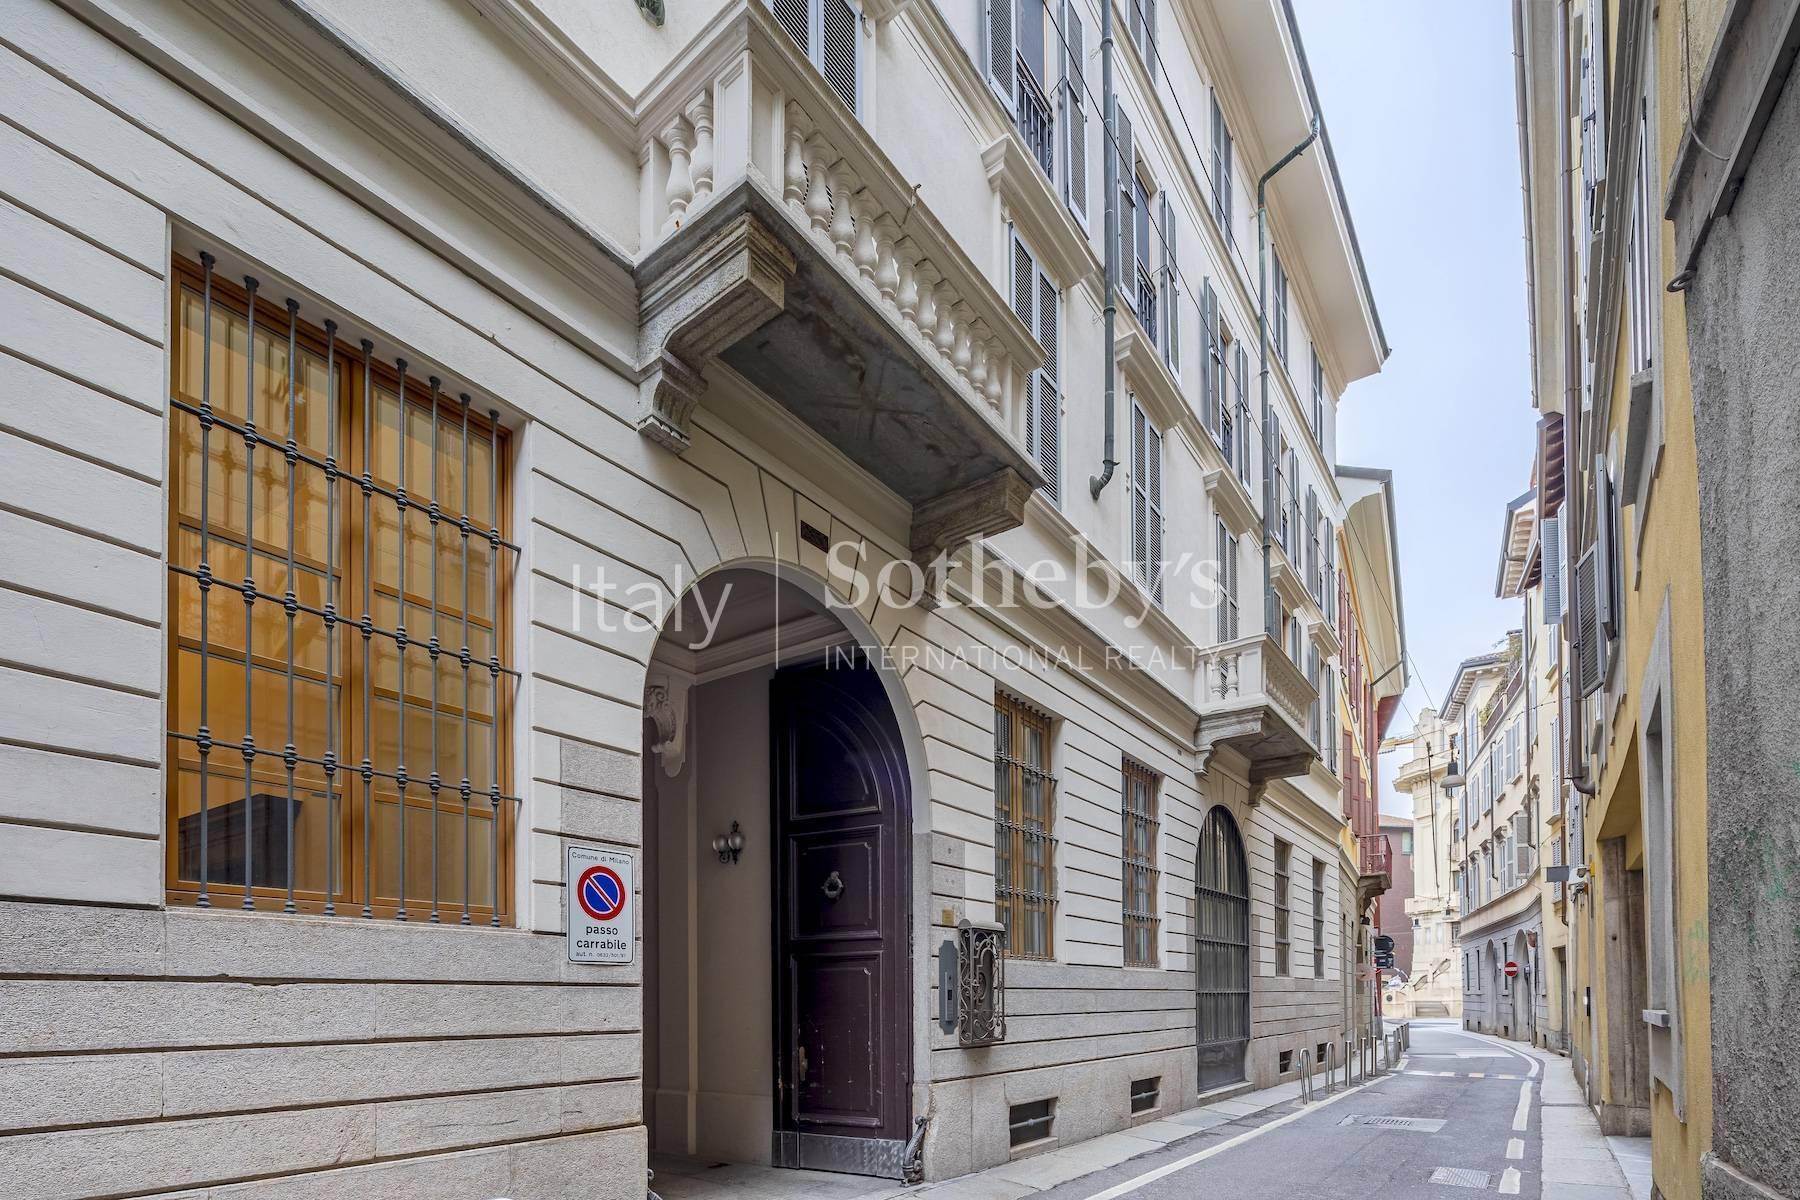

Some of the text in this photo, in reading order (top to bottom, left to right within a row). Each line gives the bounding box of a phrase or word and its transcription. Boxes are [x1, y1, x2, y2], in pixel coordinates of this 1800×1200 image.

[572, 852, 598, 861] Comune
[609, 857, 630, 865] Milano
[586, 926, 618, 935] passo
[576, 939, 627, 950] carrabile
